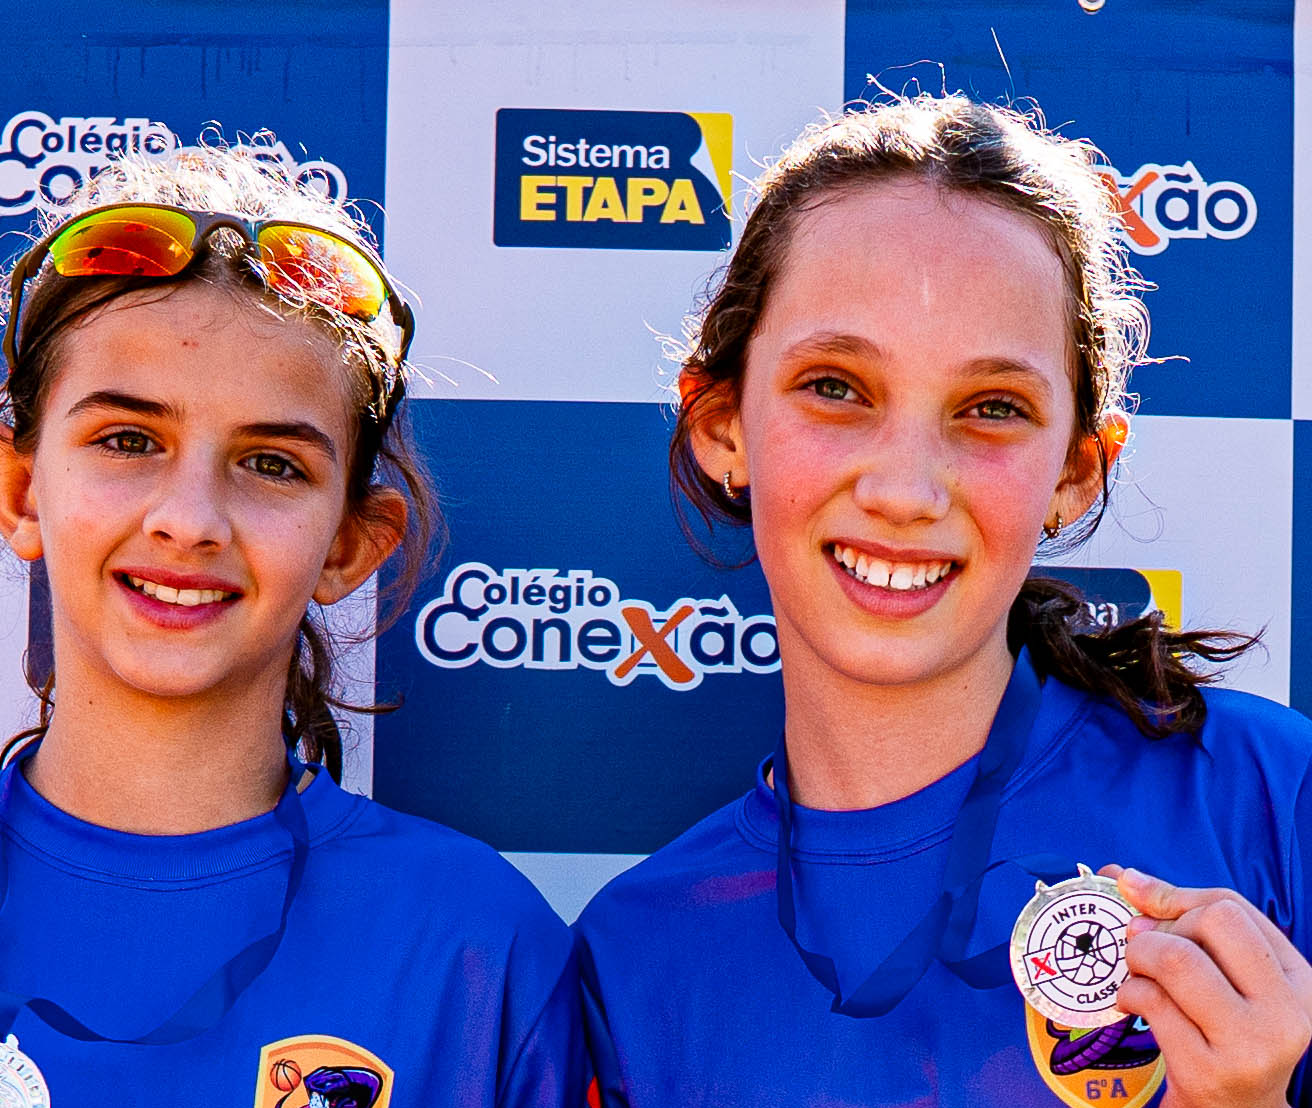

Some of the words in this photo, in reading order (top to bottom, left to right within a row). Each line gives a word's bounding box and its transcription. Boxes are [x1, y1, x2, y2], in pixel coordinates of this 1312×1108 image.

[521, 135, 670, 169] Sistema
[519, 175, 705, 225] ETAPA
[450, 569, 611, 616] Colégio
[1052, 903, 1097, 924] INTER
[1076, 981, 1120, 1004] CLASSE
